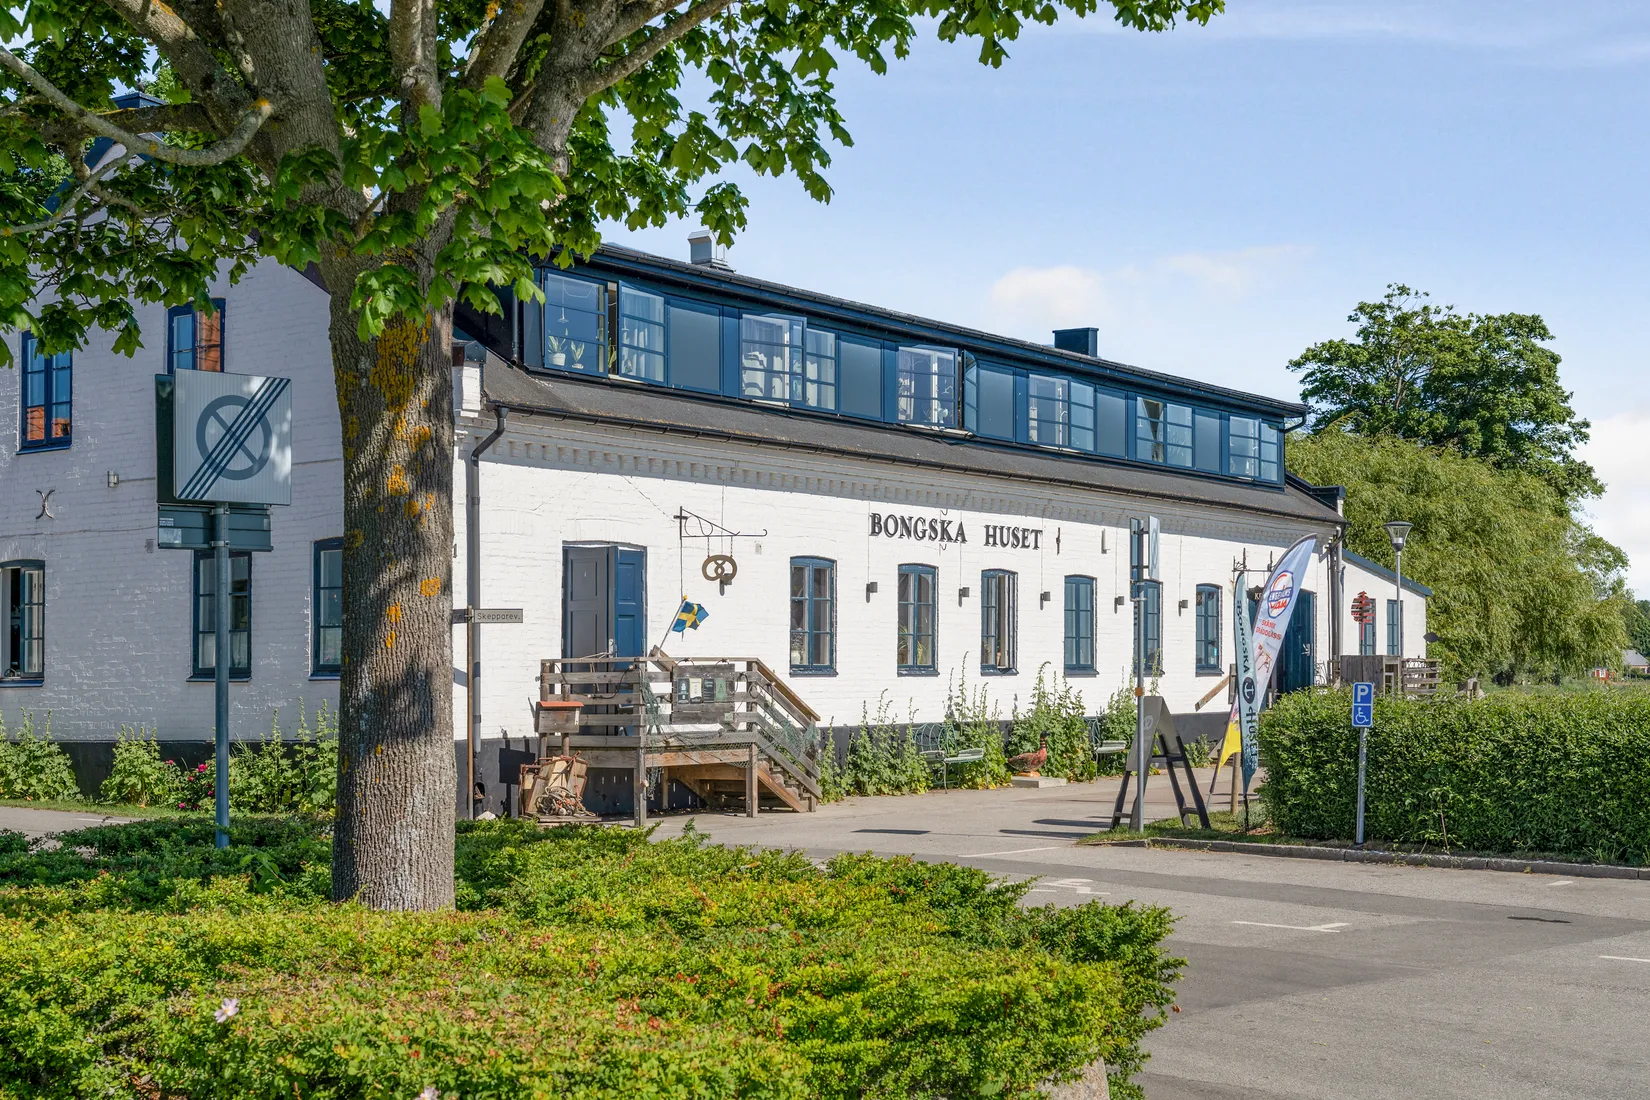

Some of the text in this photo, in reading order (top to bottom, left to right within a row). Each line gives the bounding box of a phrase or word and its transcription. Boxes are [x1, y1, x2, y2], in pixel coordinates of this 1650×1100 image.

[869, 512, 1043, 550] BONGSKA HUSET
[477, 612, 521, 621] Skepparev.
[1236, 600, 1251, 673] BONGSKA
[1356, 685, 1369, 703] P
